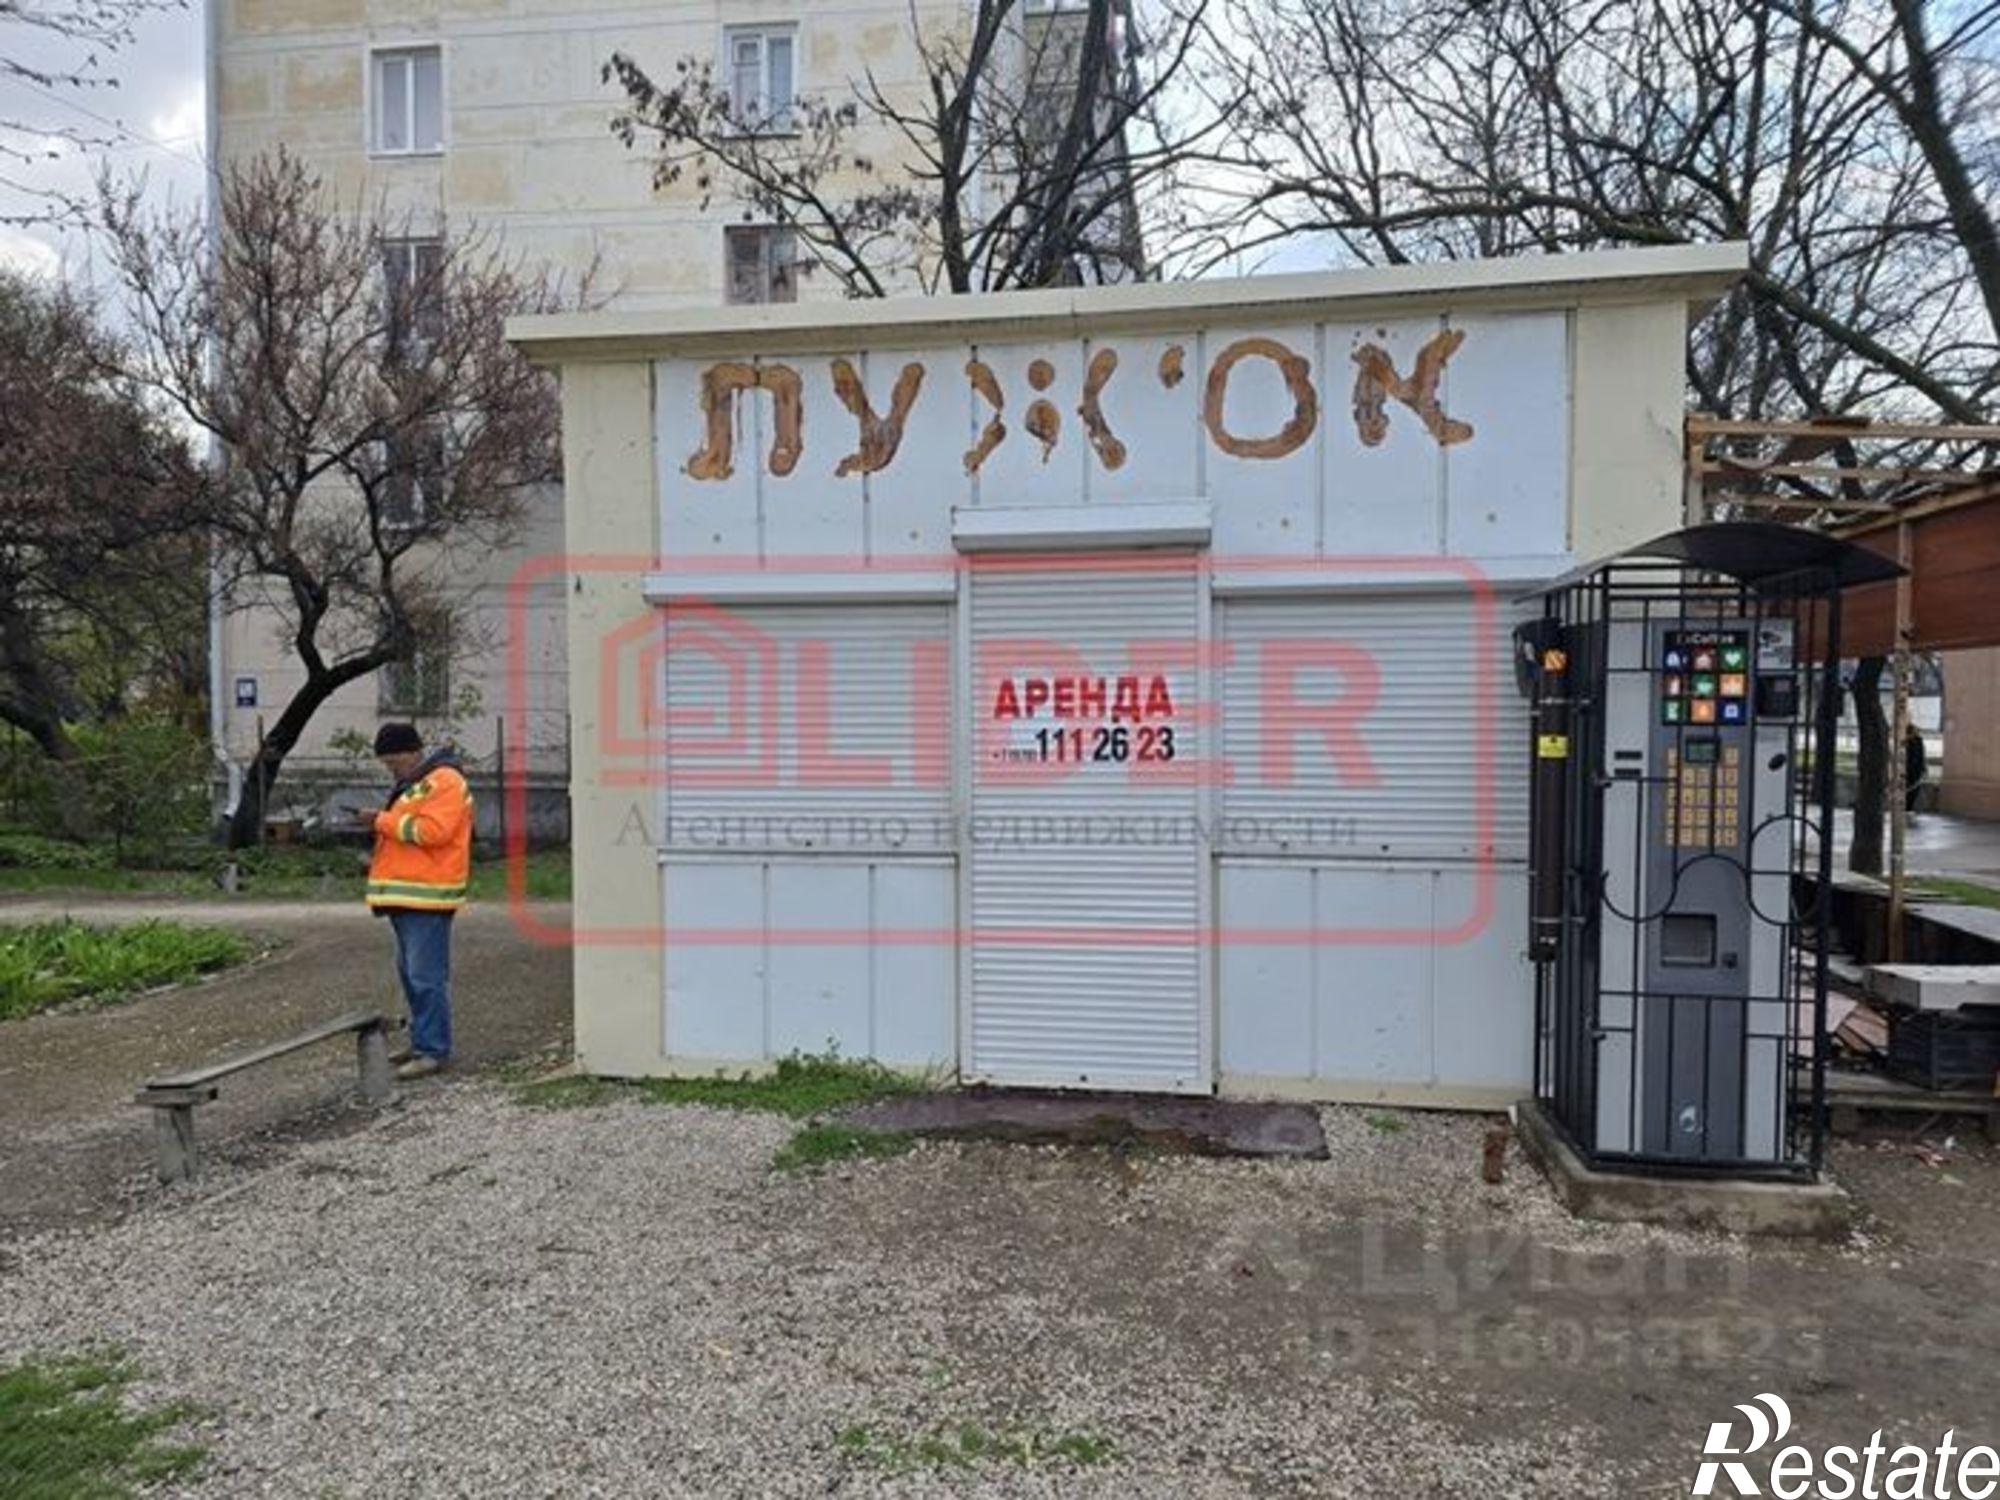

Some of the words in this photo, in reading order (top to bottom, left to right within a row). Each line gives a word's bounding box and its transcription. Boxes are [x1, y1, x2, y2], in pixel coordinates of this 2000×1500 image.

[994, 674, 1174, 722] АРЕНДА
[1037, 727, 1083, 762] 111
[1093, 727, 1129, 762] 26
[1138, 726, 1175, 761] 23
